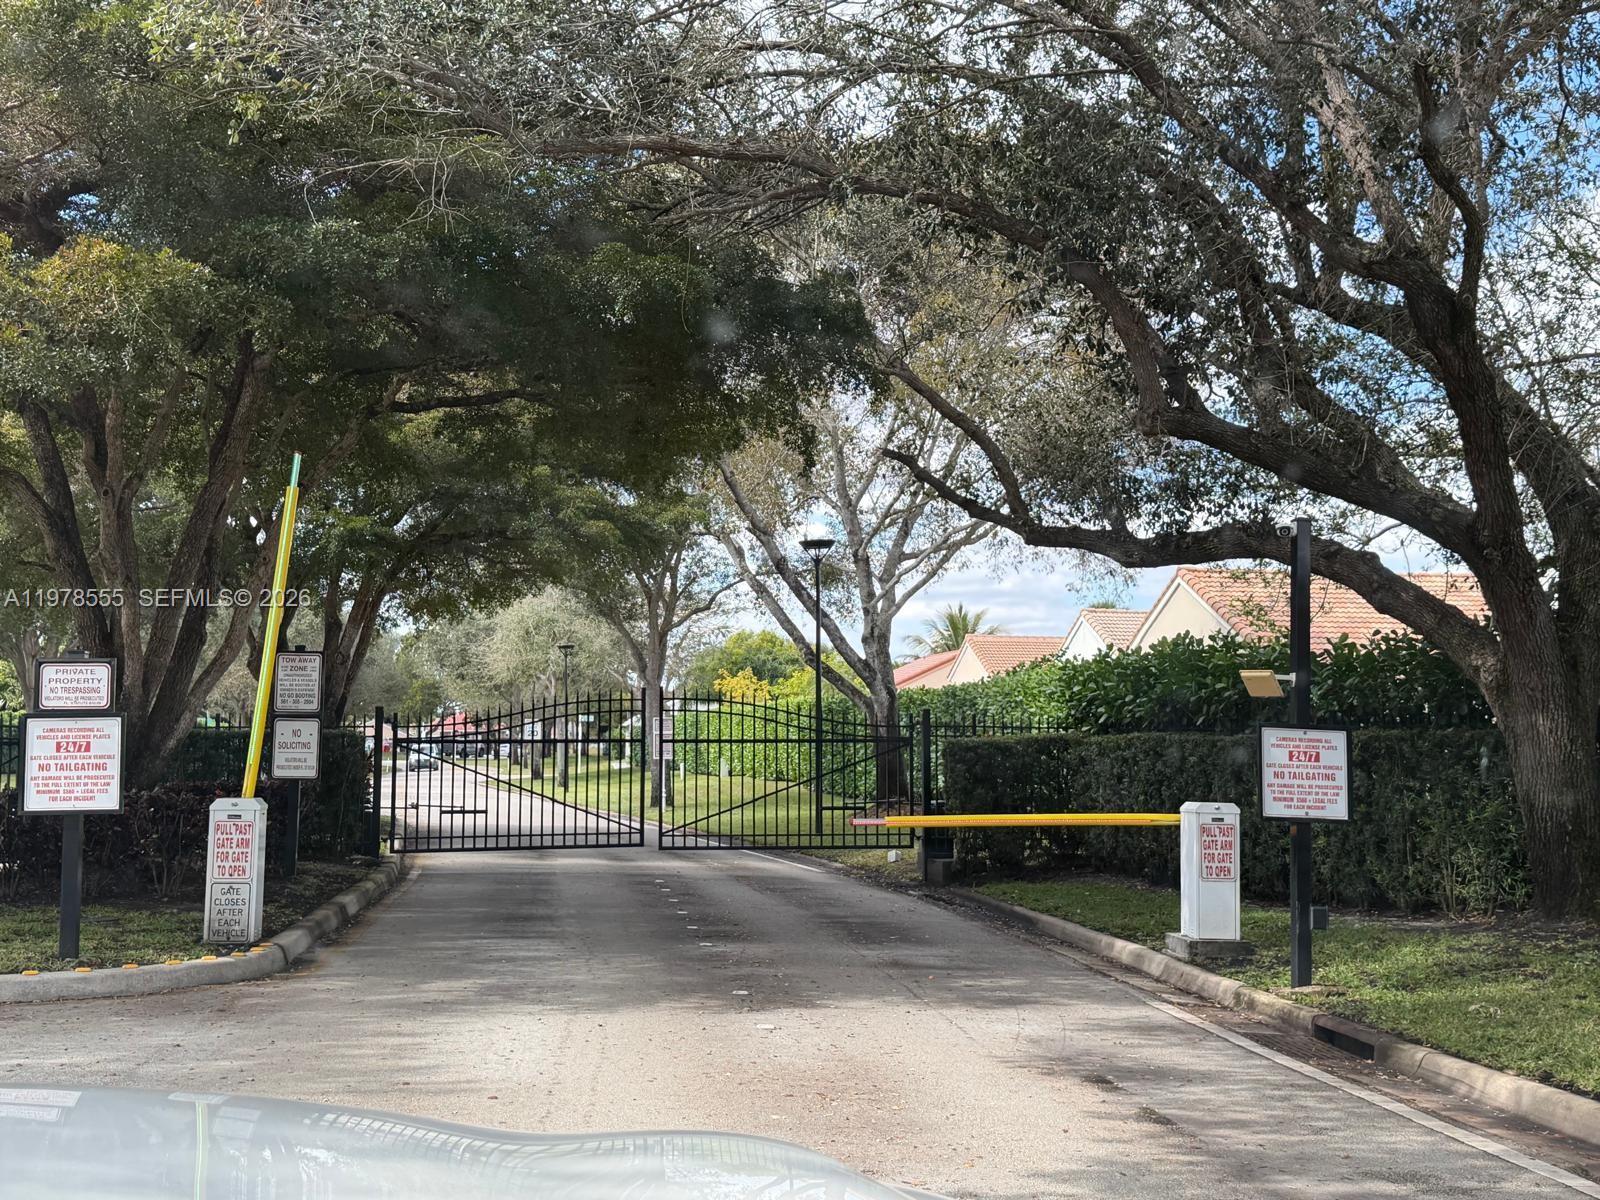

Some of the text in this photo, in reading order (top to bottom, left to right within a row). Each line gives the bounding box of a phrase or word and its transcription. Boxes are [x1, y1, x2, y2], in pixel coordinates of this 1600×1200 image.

[292, 729, 301, 738] NO
[60, 742, 86, 752] 24/7
[278, 741, 311, 750] SOLICITING
[1292, 752, 1316, 762] 24/7
[38, 762, 108, 772] NO TAILGATING
[1273, 771, 1336, 781] NO TAILGATING
[216, 824, 252, 835] PULL PAST
[1202, 827, 1233, 838] PULL PAST
[216, 838, 250, 849] GATE ARM
[1203, 840, 1232, 850] GATE ARM
[216, 852, 248, 863] FOR GATE
[1204, 853, 1232, 863] FOR GATE
[217, 865, 246, 877] TO OPEN
[1206, 866, 1231, 876] TO OPEN
